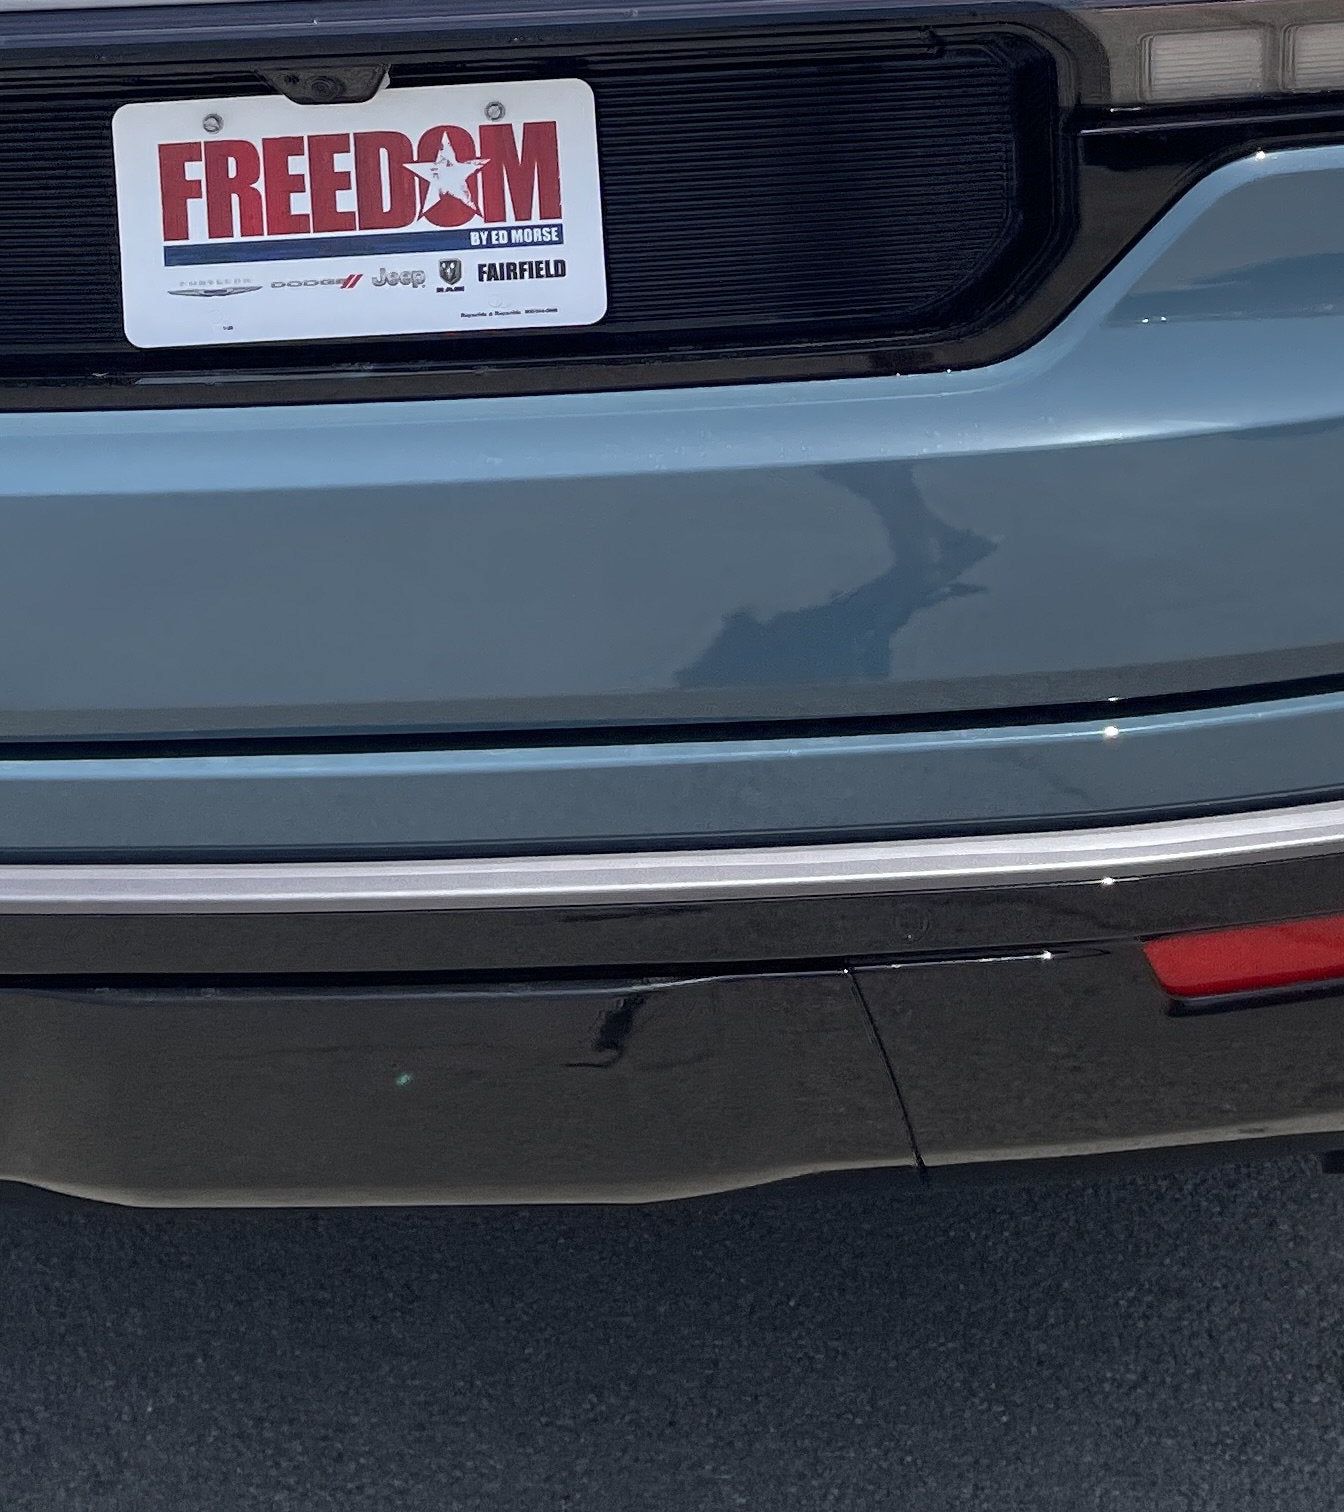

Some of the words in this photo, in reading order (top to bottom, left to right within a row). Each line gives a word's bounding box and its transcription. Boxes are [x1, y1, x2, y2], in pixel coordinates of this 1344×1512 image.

[158, 120, 563, 241] FREEDOM
[470, 230, 489, 246] BY
[491, 229, 508, 245] ED
[511, 226, 559, 243] MORSE
[372, 267, 427, 289] Jeep
[477, 259, 567, 283] FAIRFIELD
